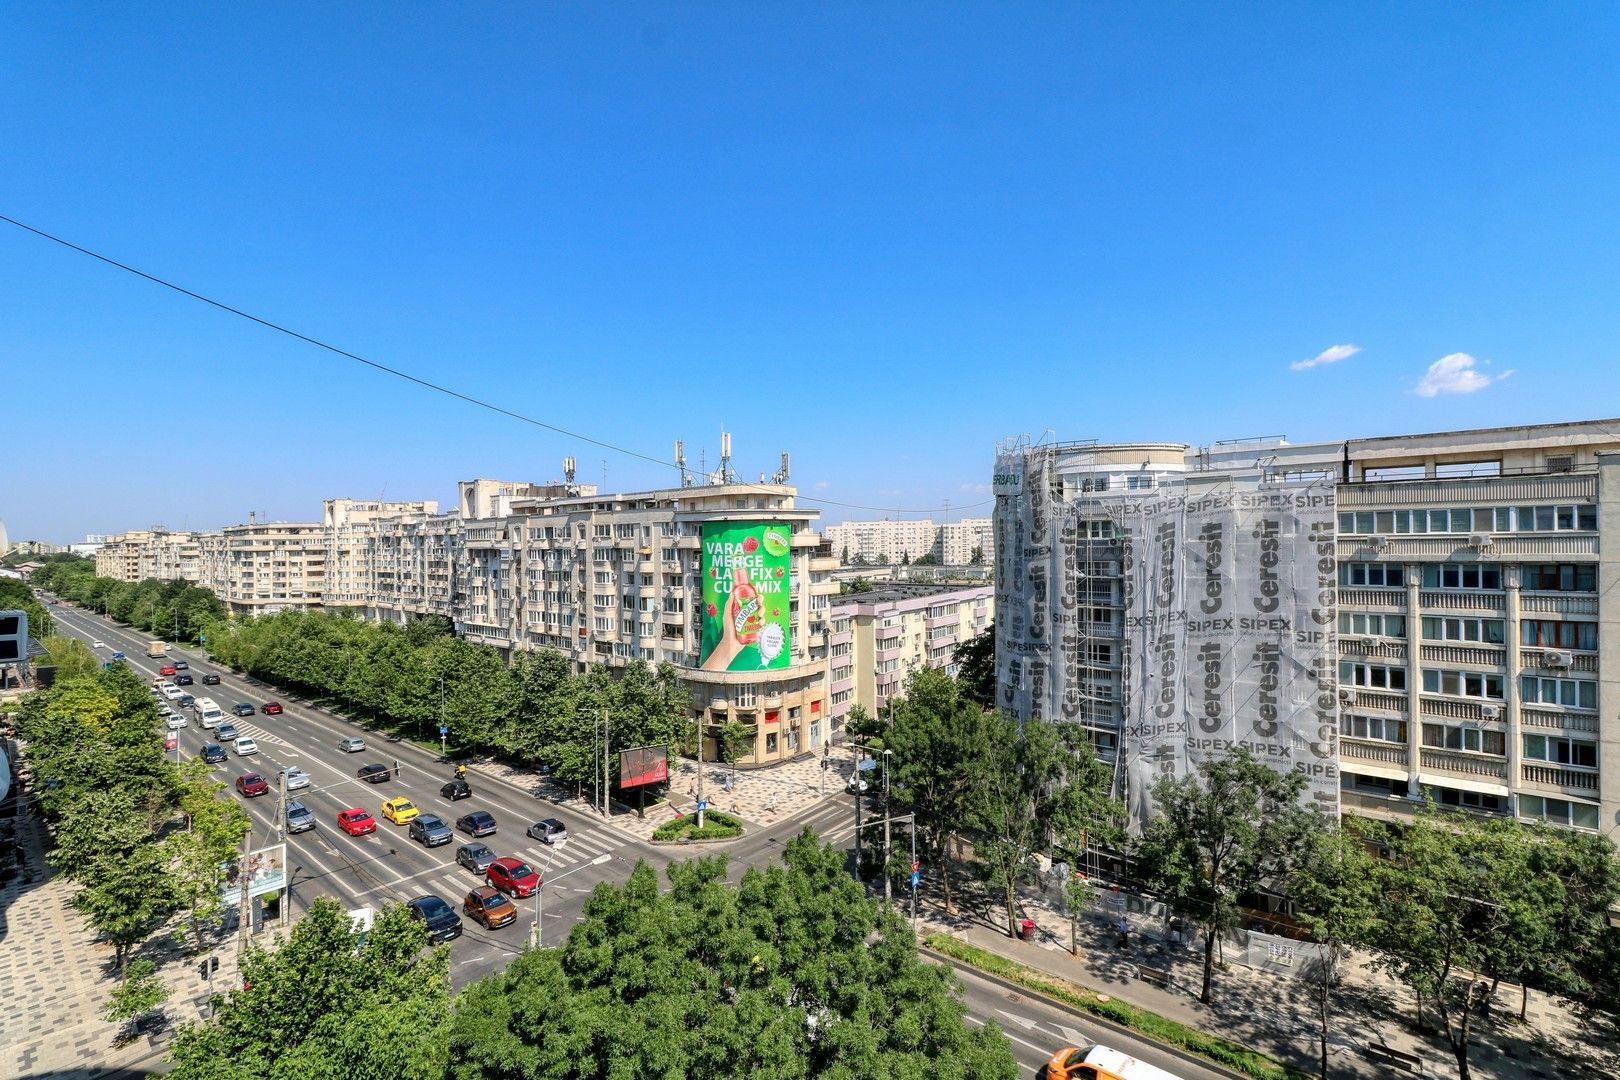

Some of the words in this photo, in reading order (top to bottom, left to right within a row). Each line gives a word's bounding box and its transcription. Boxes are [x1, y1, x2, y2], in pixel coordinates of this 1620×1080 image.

[1105, 502, 1142, 515] SIPEX
[1144, 497, 1186, 515] SIPEX
[1187, 496, 1234, 513] SIPEX
[1241, 494, 1293, 507] SIPEX
[706, 542, 745, 555] VARA
[1024, 546, 1051, 558] SIPEX
[711, 555, 763, 567] MERGE
[1060, 528, 1076, 610] Ceresit
[1155, 522, 1175, 609] Ceresit
[1198, 521, 1222, 614] Ceresit
[1252, 519, 1279, 613] Ceresit
[715, 568, 733, 580] LA
[751, 567, 774, 580] FIX
[1308, 521, 1336, 625] Ceresit
[714, 581, 733, 593] CU
[755, 581, 782, 593] MIX
[1028, 565, 1047, 639] Ceresit
[1187, 618, 1234, 632] SIPEX
[1239, 617, 1291, 631] SIPEX
[1023, 642, 1052, 652] SIPEX
[1061, 636, 1079, 718] Ceresit
[1155, 633, 1175, 719] Ceresit
[1028, 660, 1045, 720] eresit
[1197, 642, 1221, 734] Ceresit
[1252, 642, 1280, 738] Ceresit
[1306, 657, 1336, 759] Ceresit
[1143, 722, 1186, 736] SIPEX
[1187, 737, 1234, 750] SIPEX
[1238, 739, 1291, 758] SIPEX
[1295, 761, 1338, 778] SIPE
